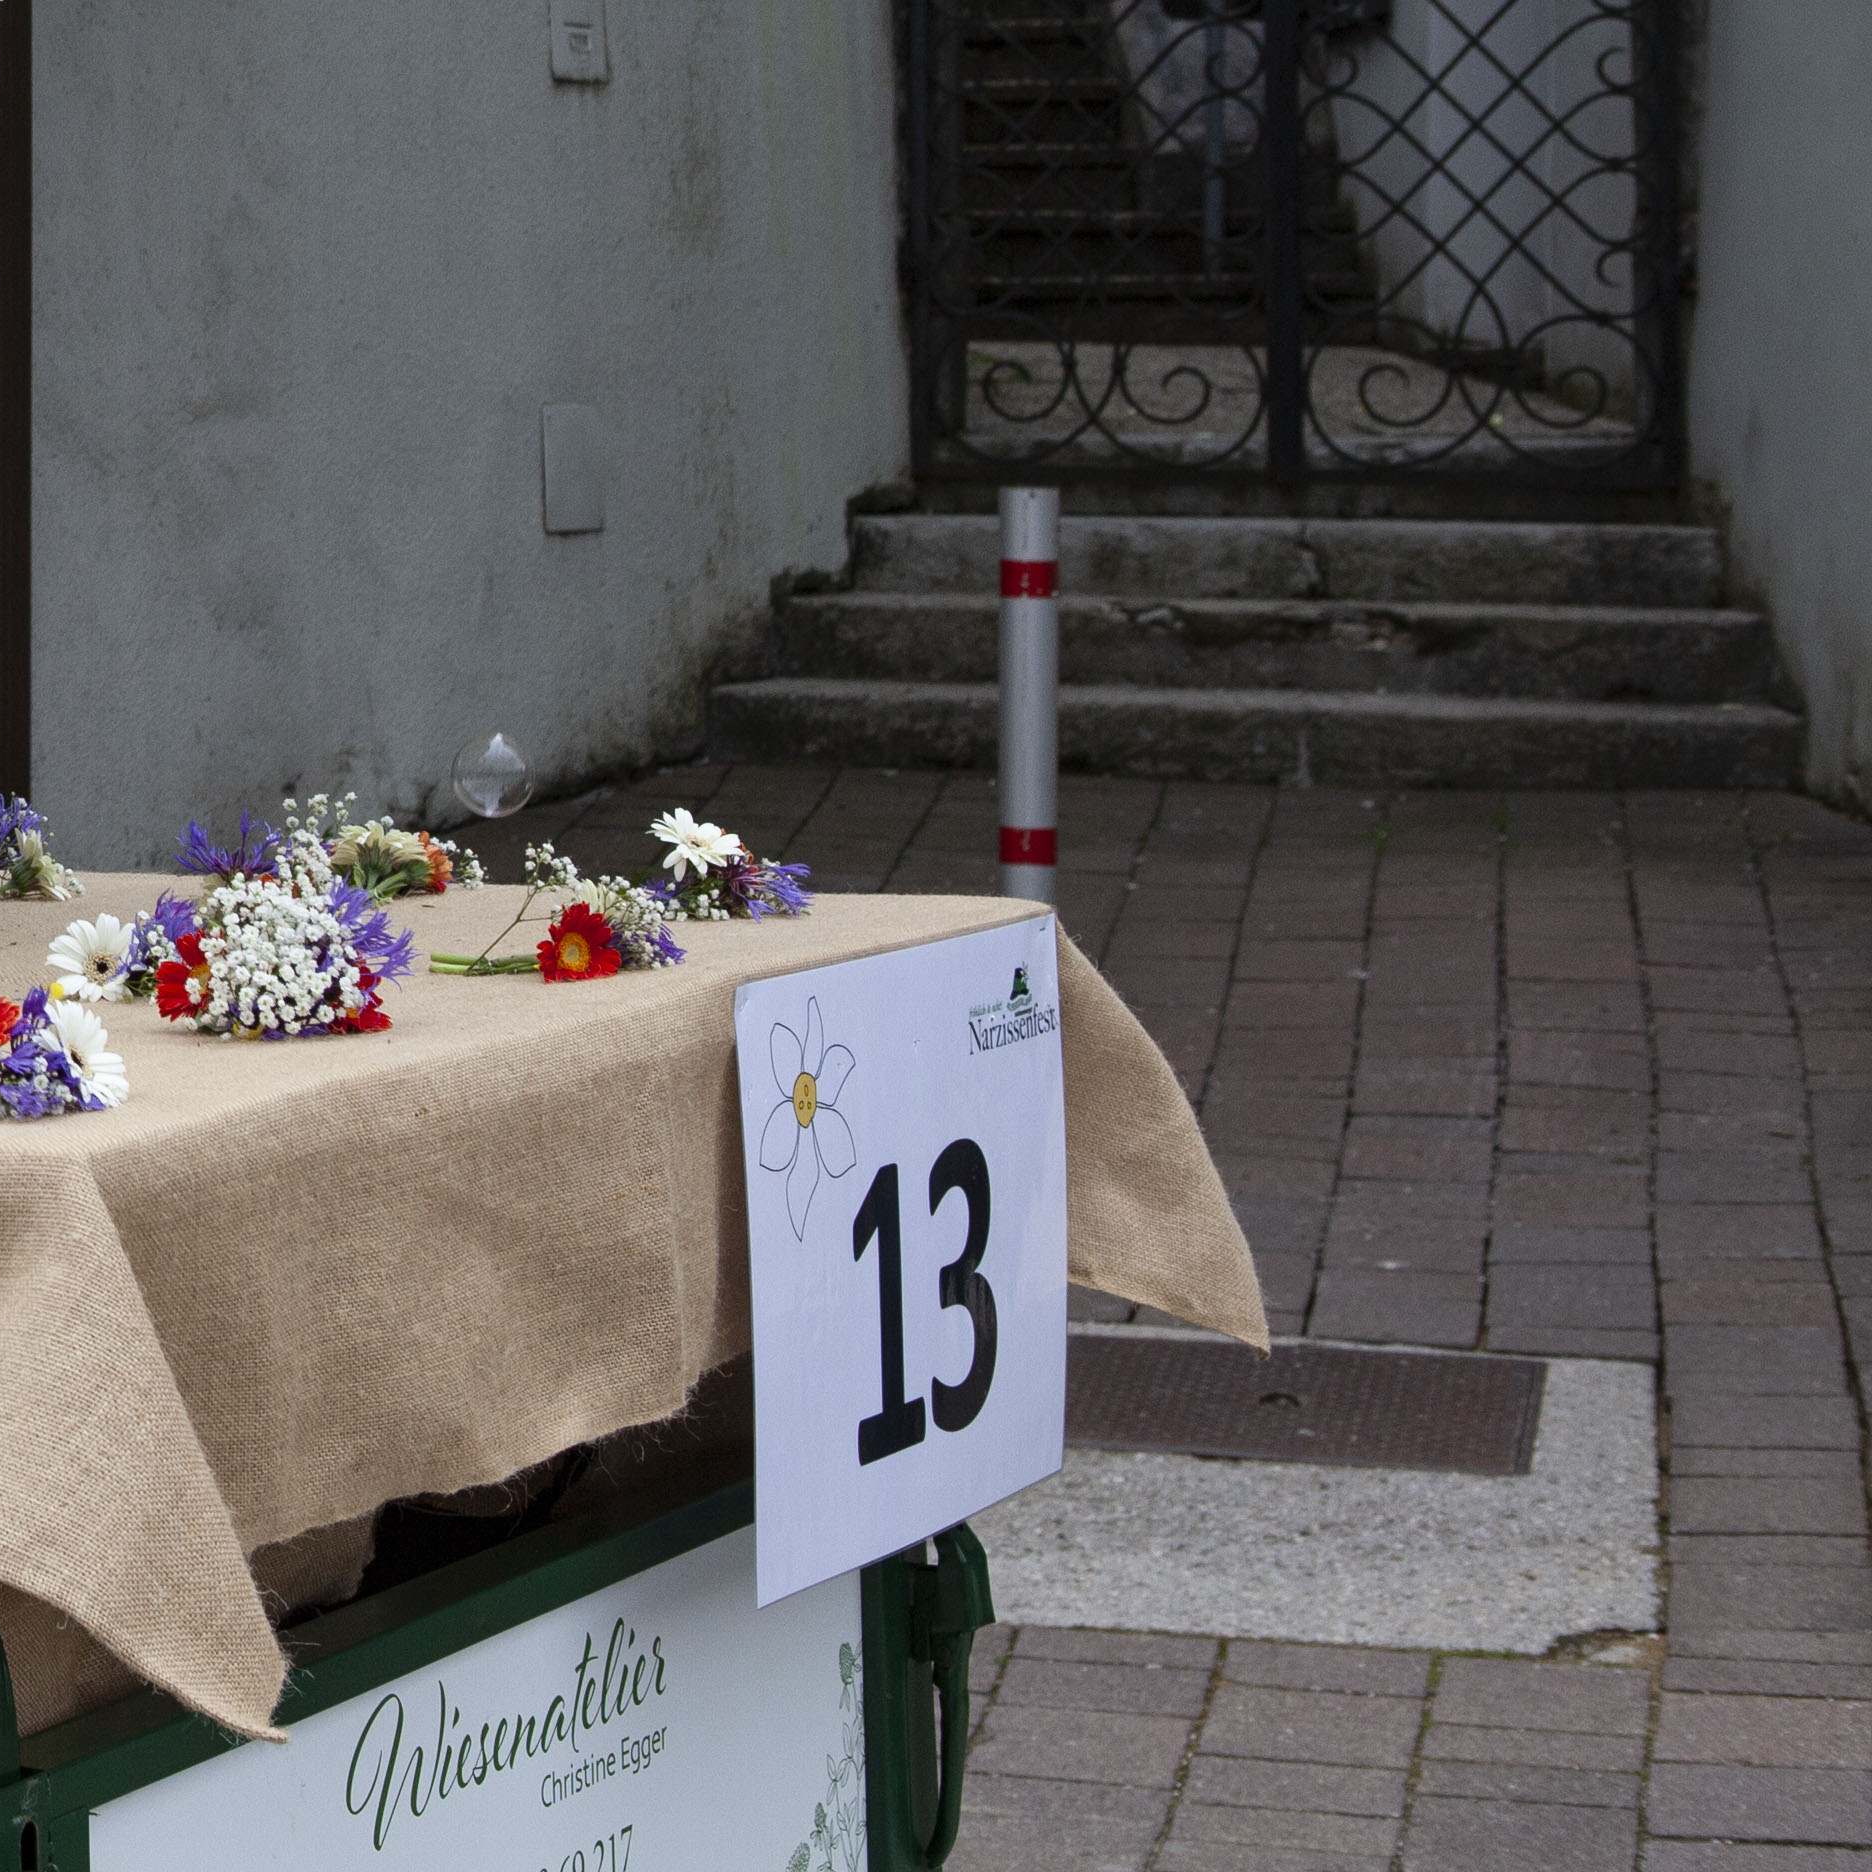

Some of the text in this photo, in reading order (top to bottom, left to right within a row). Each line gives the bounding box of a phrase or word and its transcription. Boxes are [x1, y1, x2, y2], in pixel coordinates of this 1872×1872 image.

[969, 1003, 1056, 1055] Narzissenfest
[853, 1137, 998, 1466] 13
[346, 1617, 667, 1851] Wiesenatelier
[541, 1726, 668, 1808] Christine Egger
